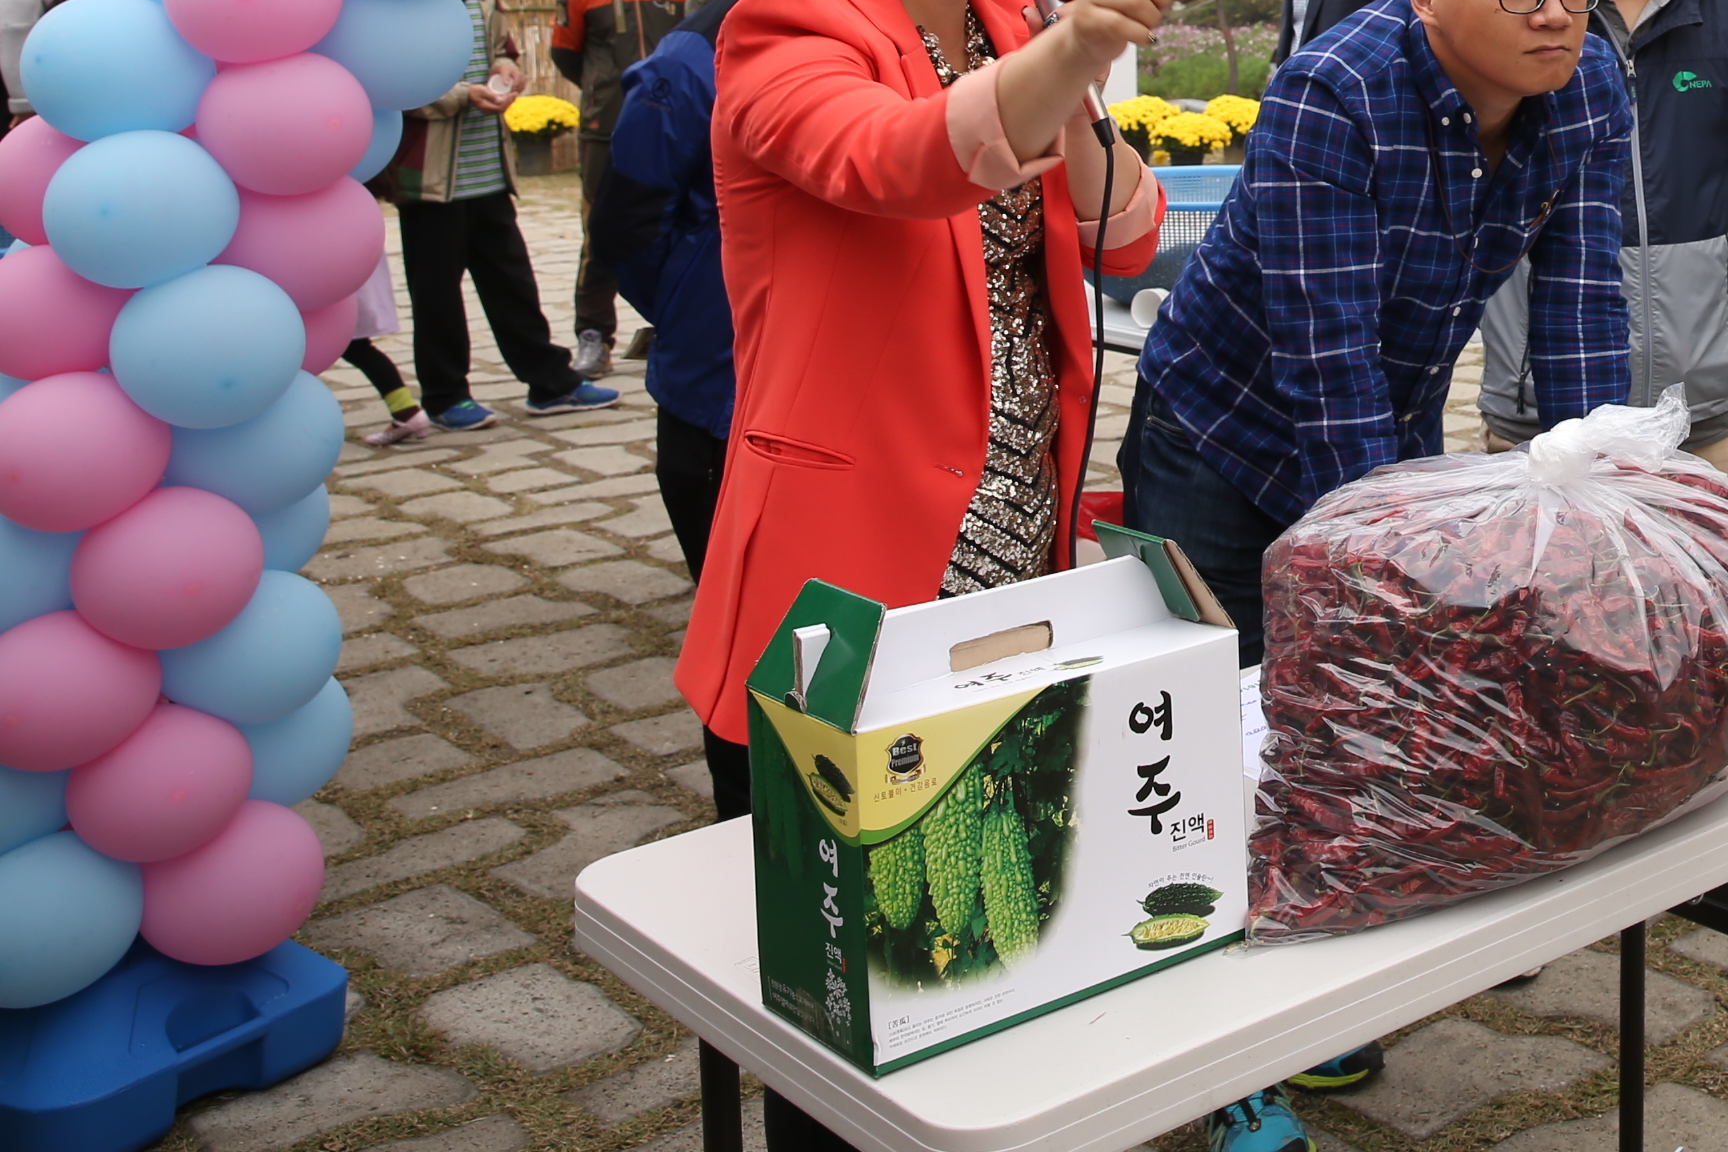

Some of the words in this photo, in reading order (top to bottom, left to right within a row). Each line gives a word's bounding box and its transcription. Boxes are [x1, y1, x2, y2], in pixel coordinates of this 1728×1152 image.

[1689, 79, 1713, 89] NEPA
[892, 743, 918, 757] Best
[890, 753, 920, 768] Premium
[1127, 690, 1182, 835] 여주
[1169, 812, 1205, 842] 진액
[873, 786, 902, 802] 신토불이
[910, 777, 938, 793] 건강음료
[1171, 843, 1188, 853] Bitter
[1188, 836, 1206, 847] Gourd
[818, 838, 844, 939] 여주
[825, 942, 842, 964] 진액
